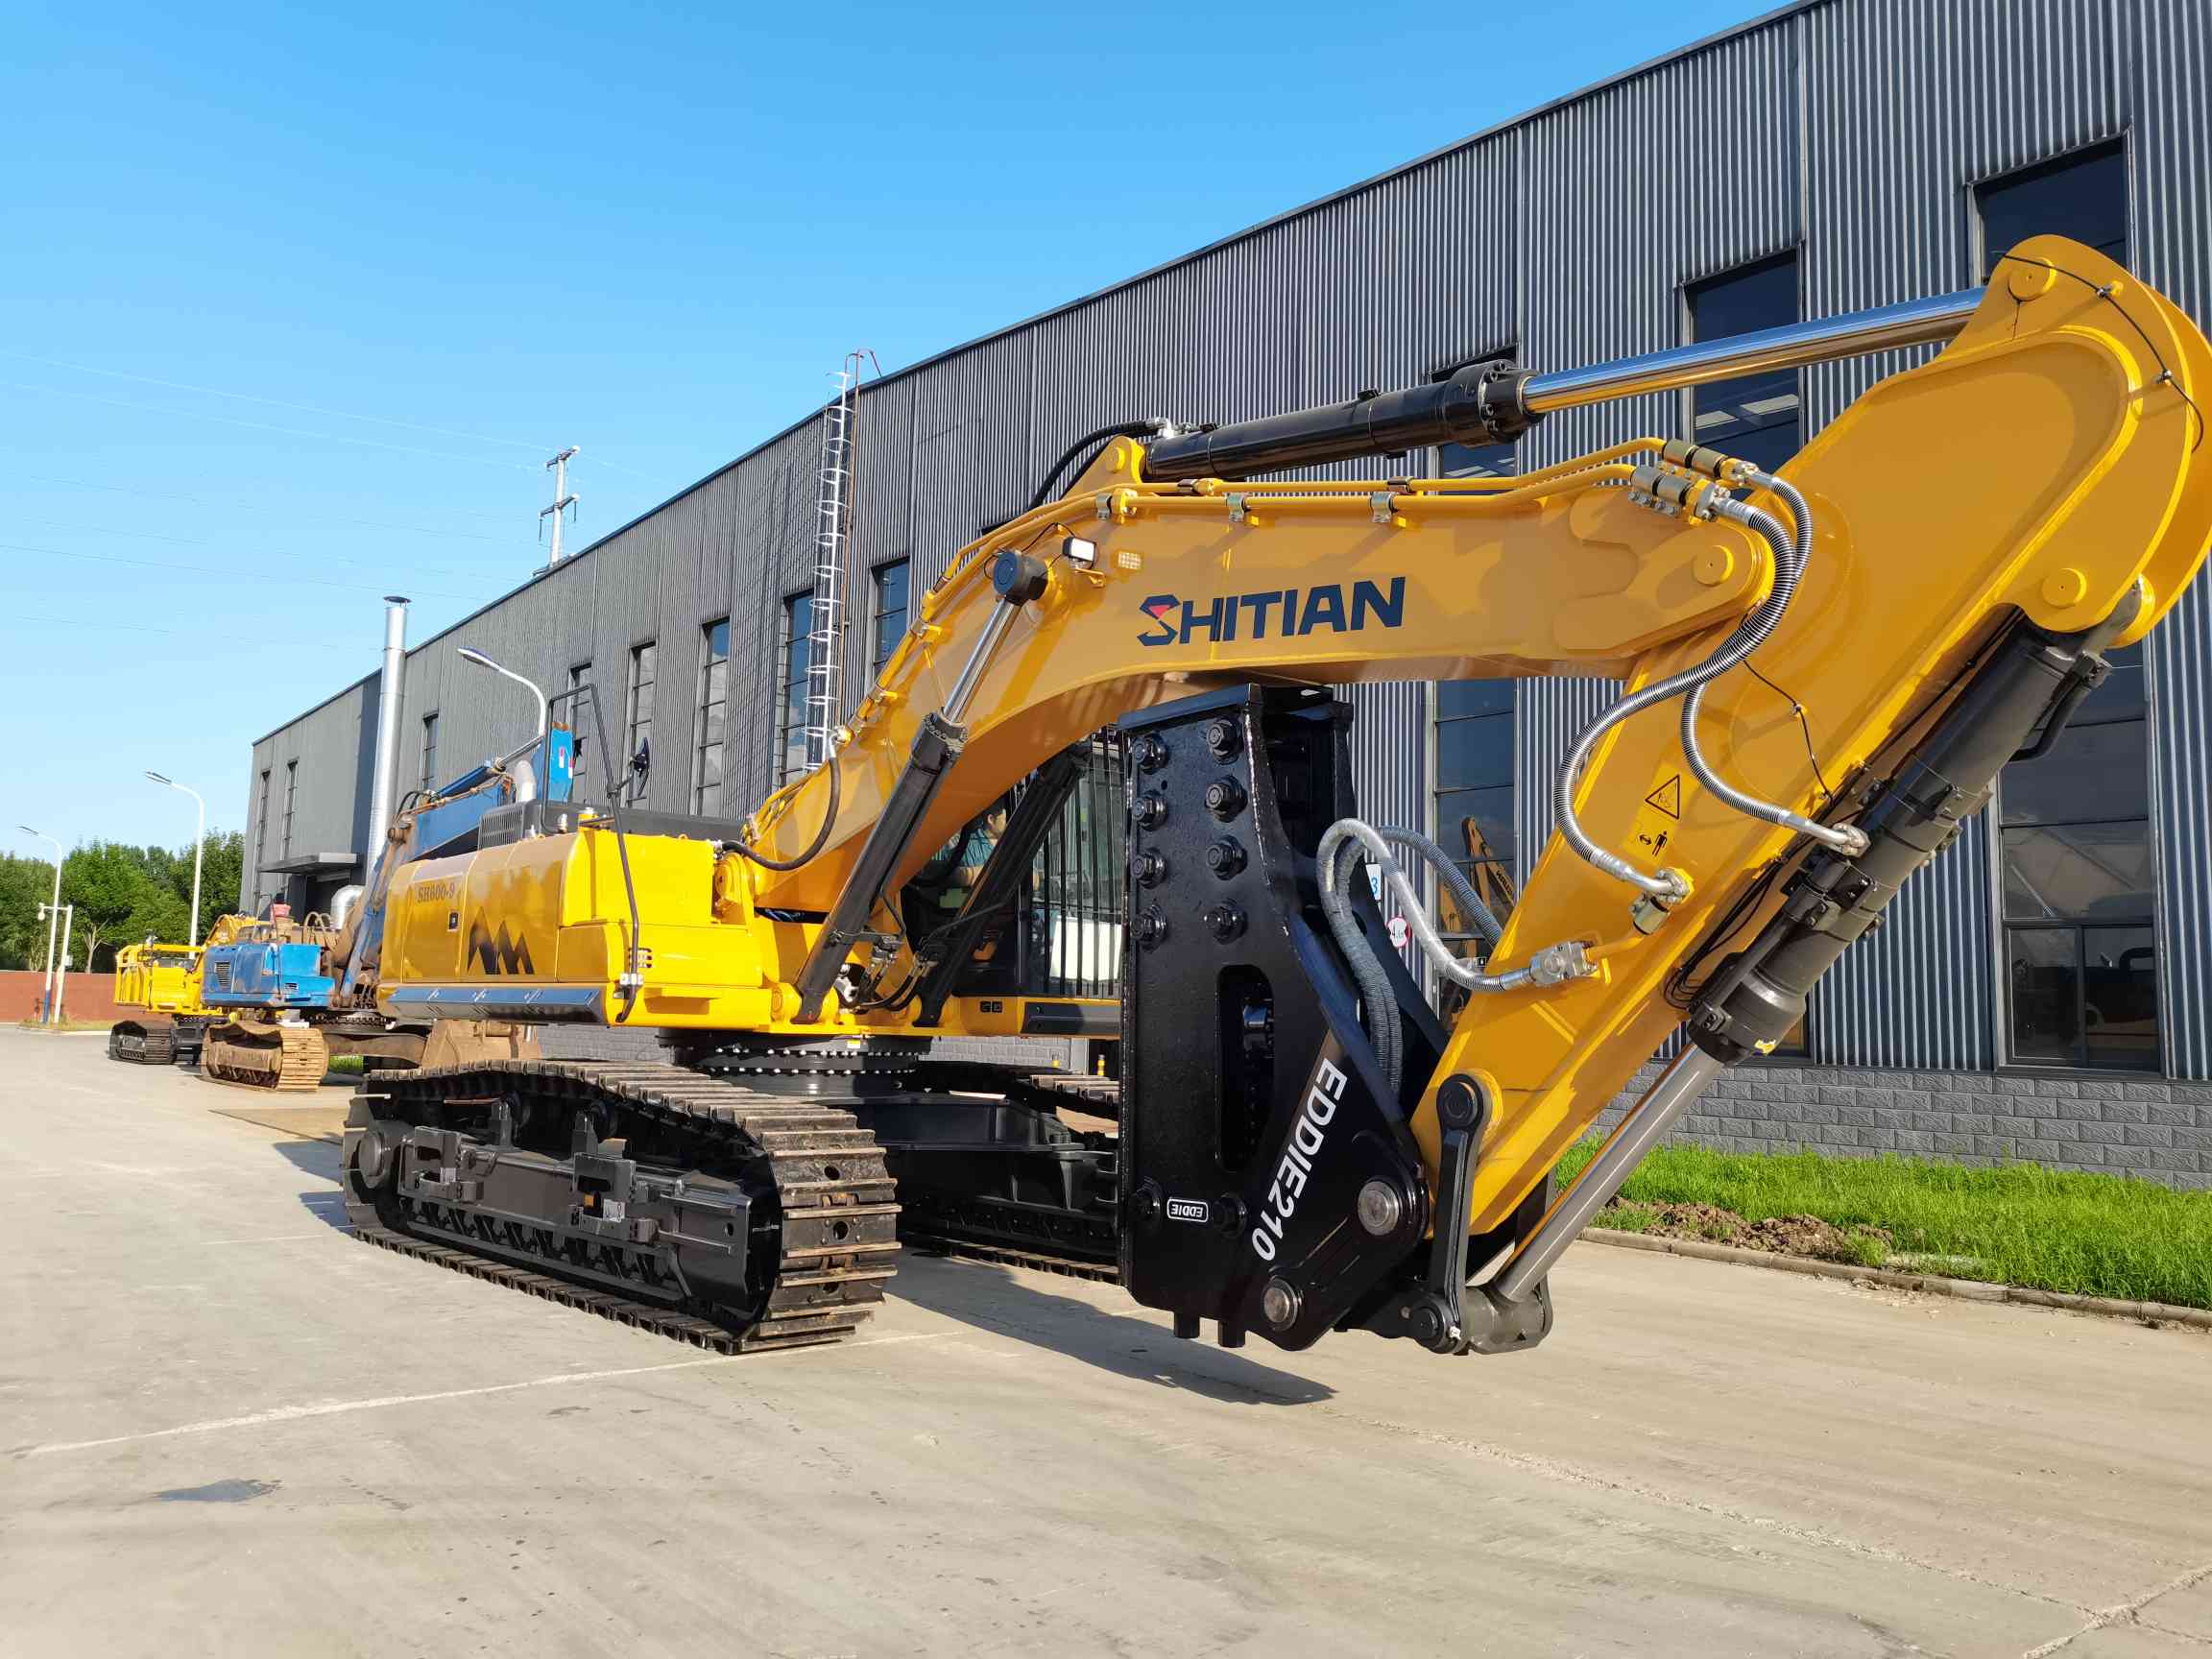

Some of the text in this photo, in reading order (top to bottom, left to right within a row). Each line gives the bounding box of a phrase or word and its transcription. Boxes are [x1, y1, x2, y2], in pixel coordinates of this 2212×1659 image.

[1137, 577, 1406, 646] SHITIAN
[1252, 1058, 1348, 1262] EDDIE210
[1170, 1204, 1203, 1217] EDDIE
